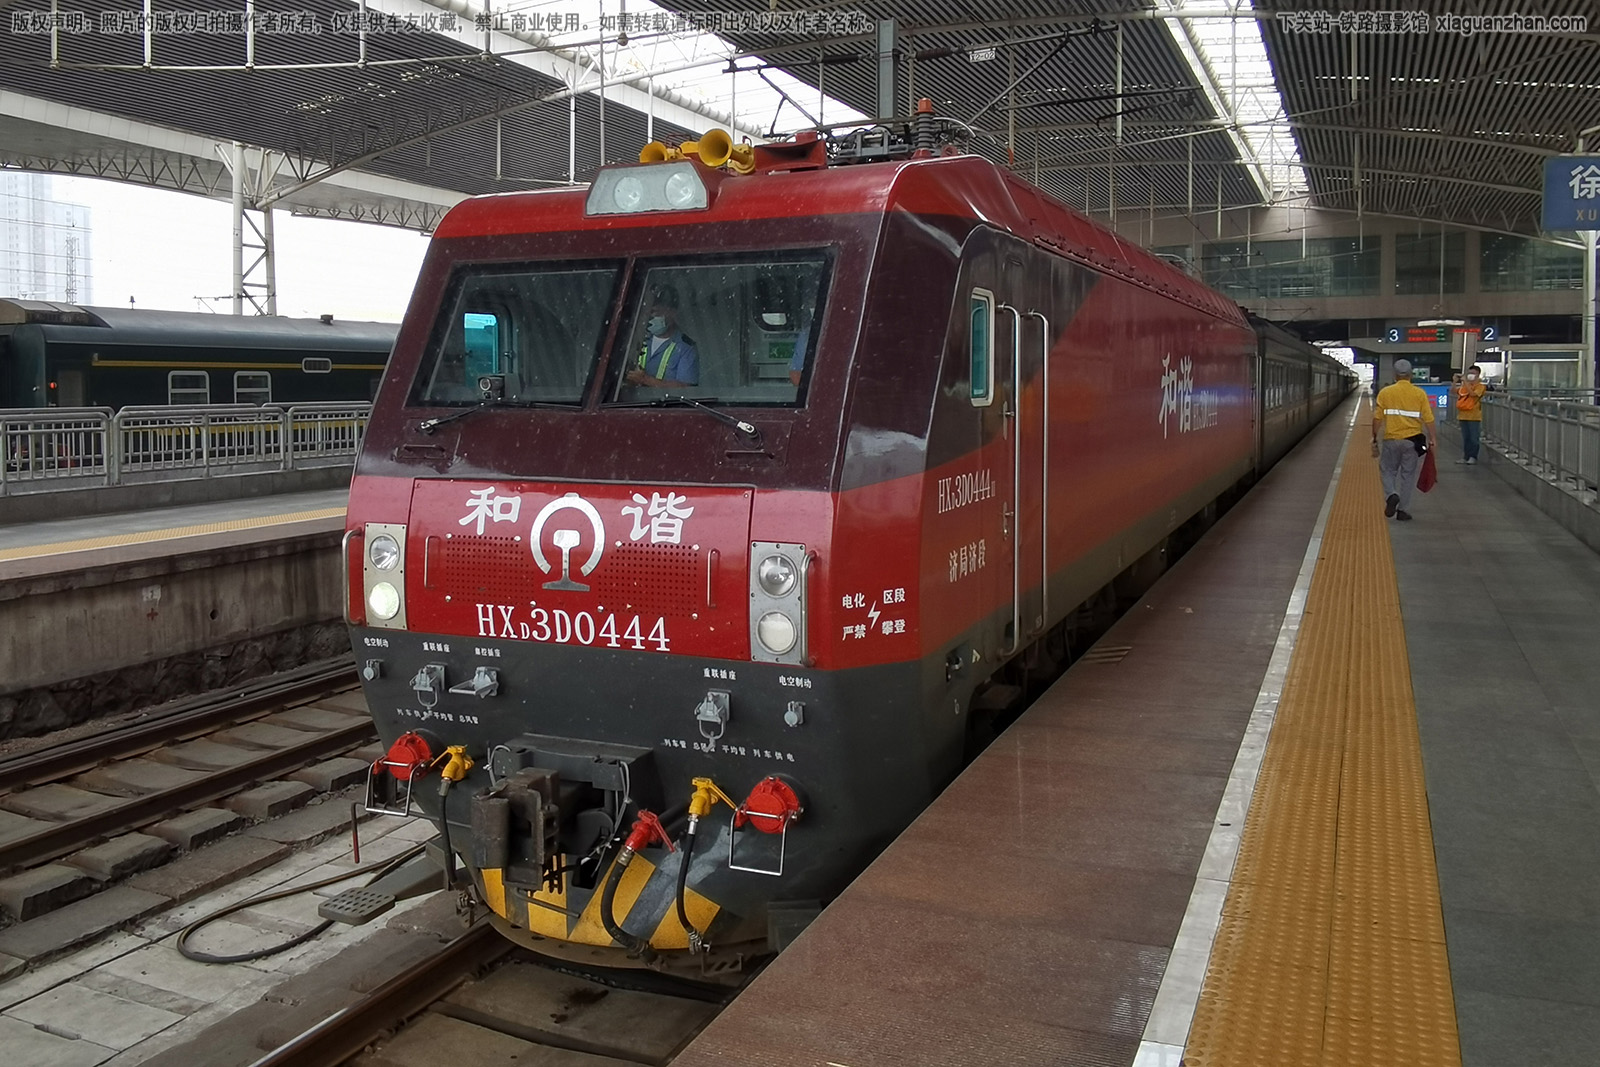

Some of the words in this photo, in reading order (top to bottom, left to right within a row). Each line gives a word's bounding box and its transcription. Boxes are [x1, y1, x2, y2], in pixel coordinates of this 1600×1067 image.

[1569, 164, 1600, 199] 徐
[1389, 328, 1399, 342] 3
[1484, 327, 1494, 340] 2
[1159, 352, 1194, 439] 和谐
[459, 486, 521, 536] 和
[622, 492, 694, 545] 谐
[842, 593, 866, 609] 电化
[883, 588, 905, 604] 区段
[842, 624, 867, 641] 严禁
[881, 619, 906, 636] 攀登
[703, 667, 737, 681] 重联插座
[778, 675, 812, 689] 电空制动
